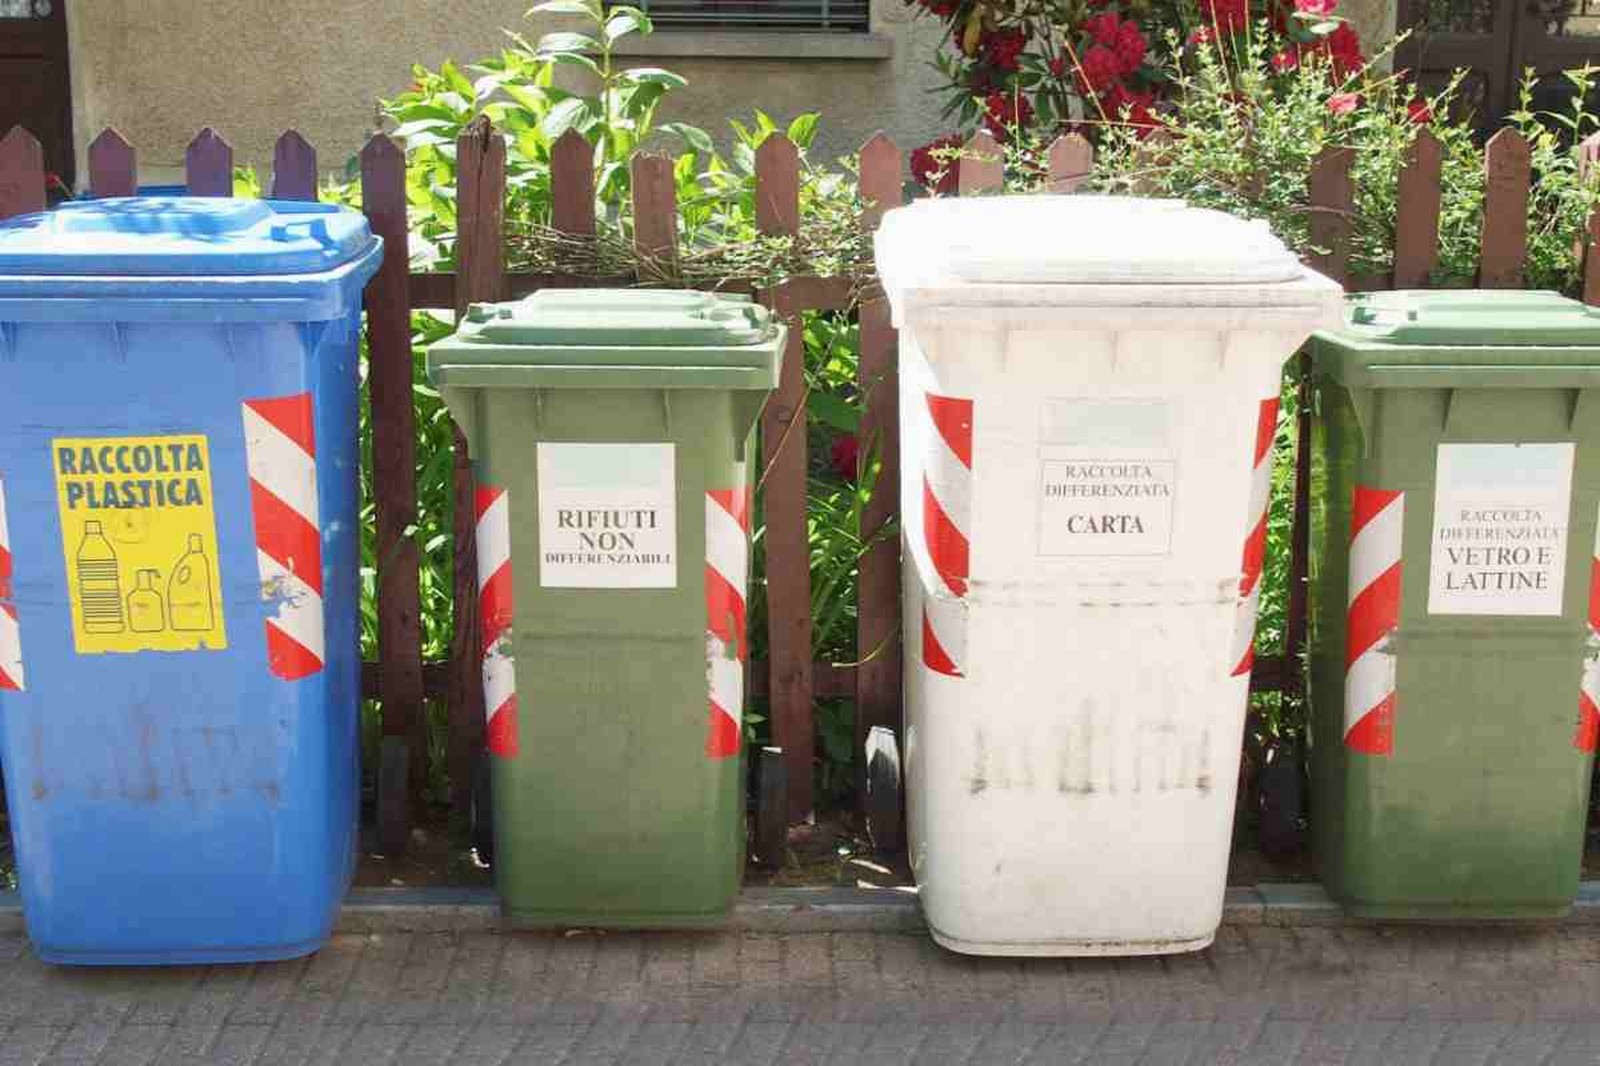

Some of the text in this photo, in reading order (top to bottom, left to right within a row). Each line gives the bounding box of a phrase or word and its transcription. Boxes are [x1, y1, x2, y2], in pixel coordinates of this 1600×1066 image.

[58, 444, 204, 475] RACCOLTA
[1066, 464, 1153, 479] RACCOLTA
[66, 478, 203, 510] PLASTICA
[1045, 483, 1170, 498] DIFFERENZIATA
[558, 509, 657, 529] RIFIUTI
[1067, 514, 1144, 534] CARTA
[1460, 509, 1542, 522] RACCOLTA
[579, 531, 635, 551] NON
[545, 553, 671, 565] DIFFERENZIABILI
[1448, 546, 1552, 566] VETRO E
[1446, 570, 1548, 590] LATTINE
